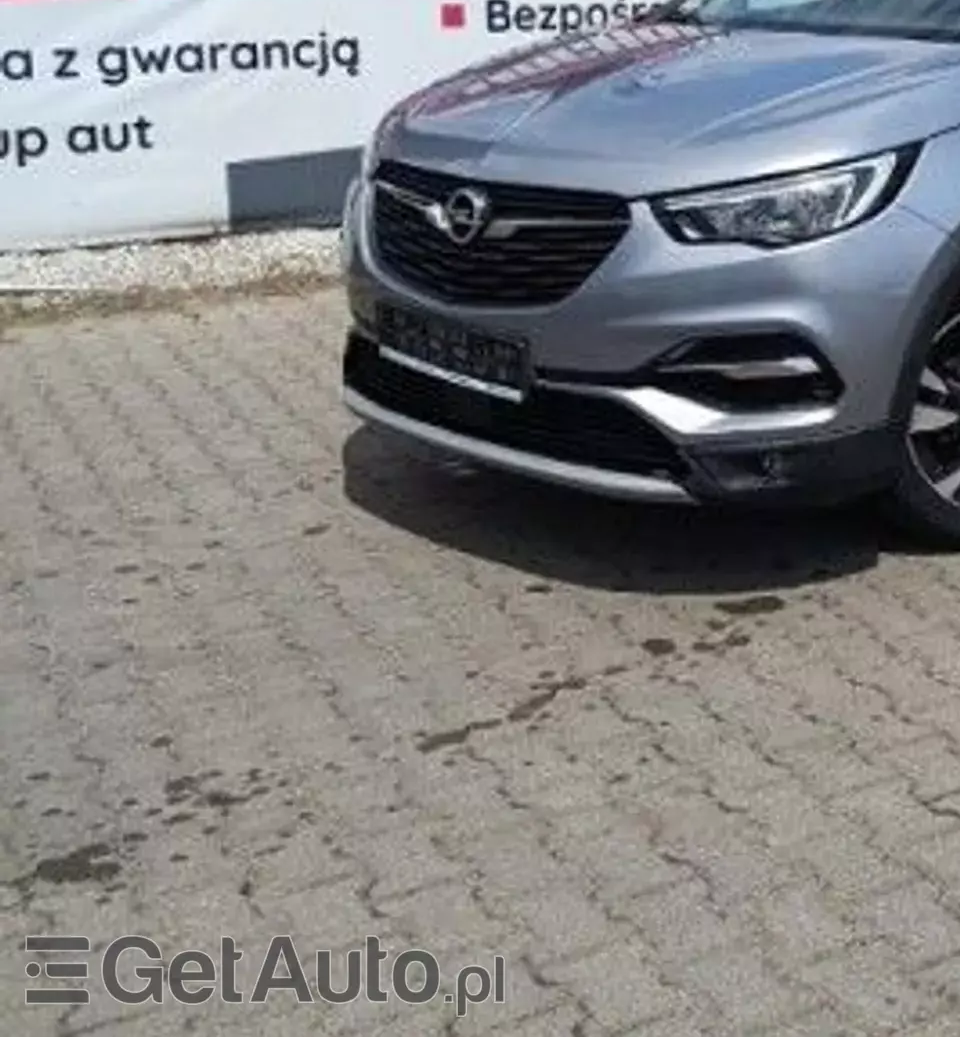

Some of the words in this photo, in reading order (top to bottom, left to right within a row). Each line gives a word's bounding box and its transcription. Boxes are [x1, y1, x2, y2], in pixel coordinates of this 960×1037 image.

[53, 47, 80, 79] z
[97, 30, 359, 87] gwarancją
[67, 115, 154, 155] aut
